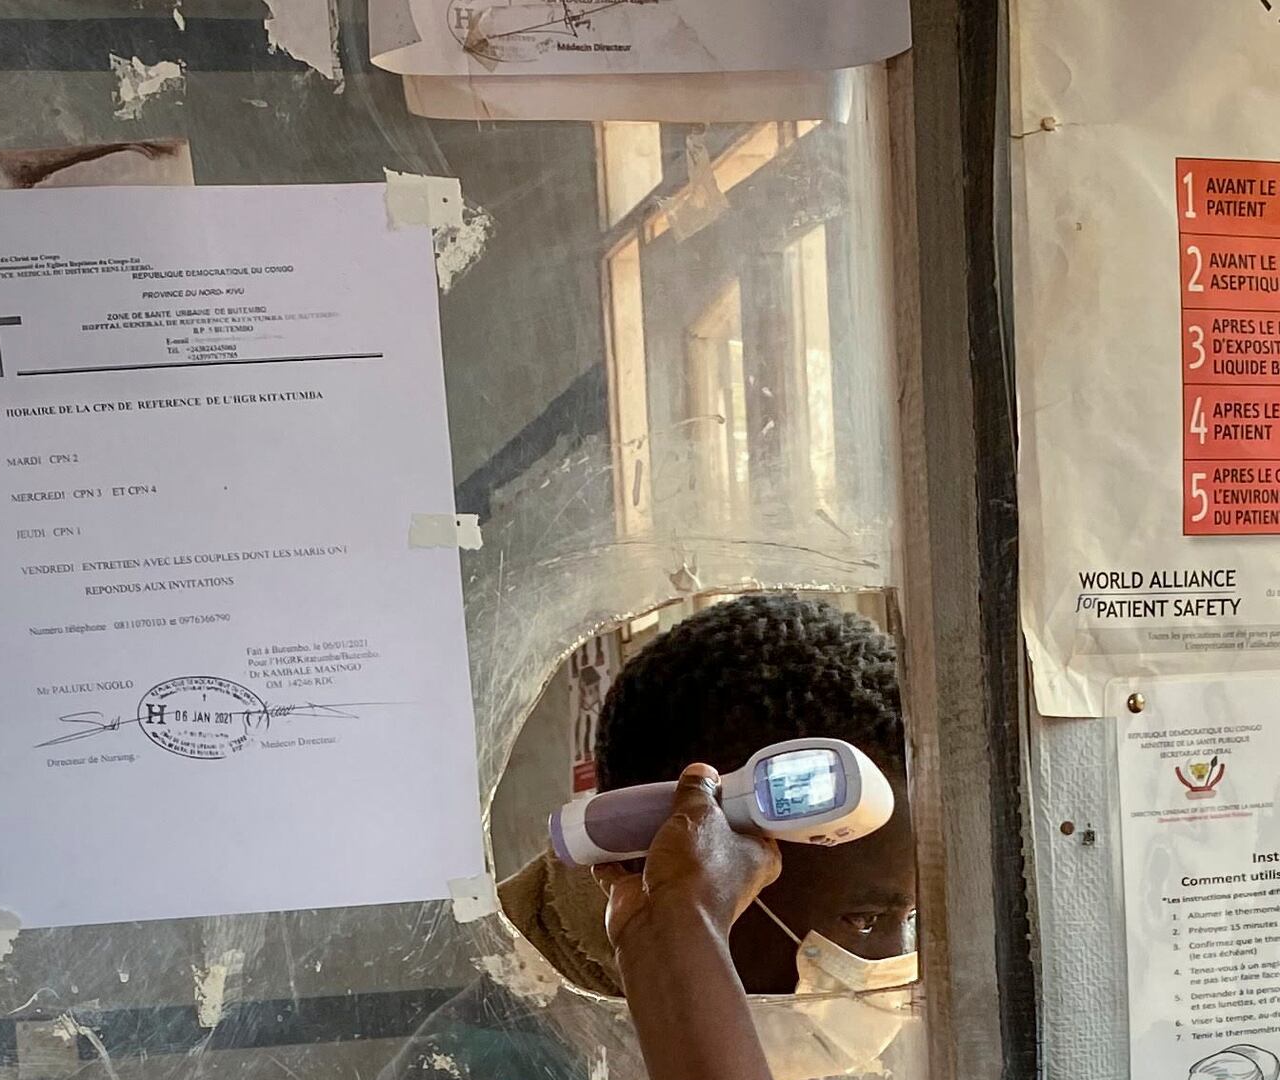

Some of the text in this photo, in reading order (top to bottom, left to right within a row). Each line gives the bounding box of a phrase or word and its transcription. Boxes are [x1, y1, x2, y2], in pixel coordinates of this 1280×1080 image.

[1183, 172, 1196, 218] 1
[1207, 178, 1256, 195] AVANT
[1260, 181, 1275, 196] LE
[1207, 200, 1266, 217] PATIENT
[1187, 246, 1203, 292] 2
[1210, 253, 1256, 270] AVANT
[1261, 256, 1276, 270] LE
[132, 270, 183, 280] REPUBLIQUE
[186, 267, 249, 277] DEMOCRATIQUE
[1212, 319, 1255, 335] APRES
[1260, 321, 1274, 335] LE
[1189, 325, 1205, 369] 3
[1214, 360, 1267, 375] LIQUIDE
[6, 391, 323, 417] HORAIRE DE LA CPN DE REFERENCE DE L'HGR KITATUMBA
[1213, 403, 1260, 418] APRES
[1264, 404, 1280, 418] LE
[1190, 396, 1207, 445] 4
[1214, 425, 1272, 440] PATIENT
[7, 454, 79, 467] MARDI CPN 2
[1213, 468, 1254, 483] APRES
[1258, 469, 1272, 483] LE
[11, 491, 65, 502] MERCREDI
[73, 489, 94, 498] CPN
[97, 489, 101, 497] 3
[112, 487, 125, 496] ET
[128, 486, 148, 495] CPN
[1192, 473, 1208, 522] 5
[1214, 511, 1231, 525] DU
[16, 527, 81, 539] JEUDI CPN 1
[21, 545, 348, 575] VENDREDI ENTRETIEN AVEC LES COUPLES DONT LES MARIS ONT
[85, 577, 234, 595] REPONDUS AUX INVITATIONS
[1079, 570, 1236, 589] WORLD ALLIANCE
[1075, 594, 1241, 618] for PATIENT SAFETY
[145, 704, 167, 724] H
[175, 710, 232, 723] 06 JAN 2021
[1182, 873, 1246, 887] Comment
